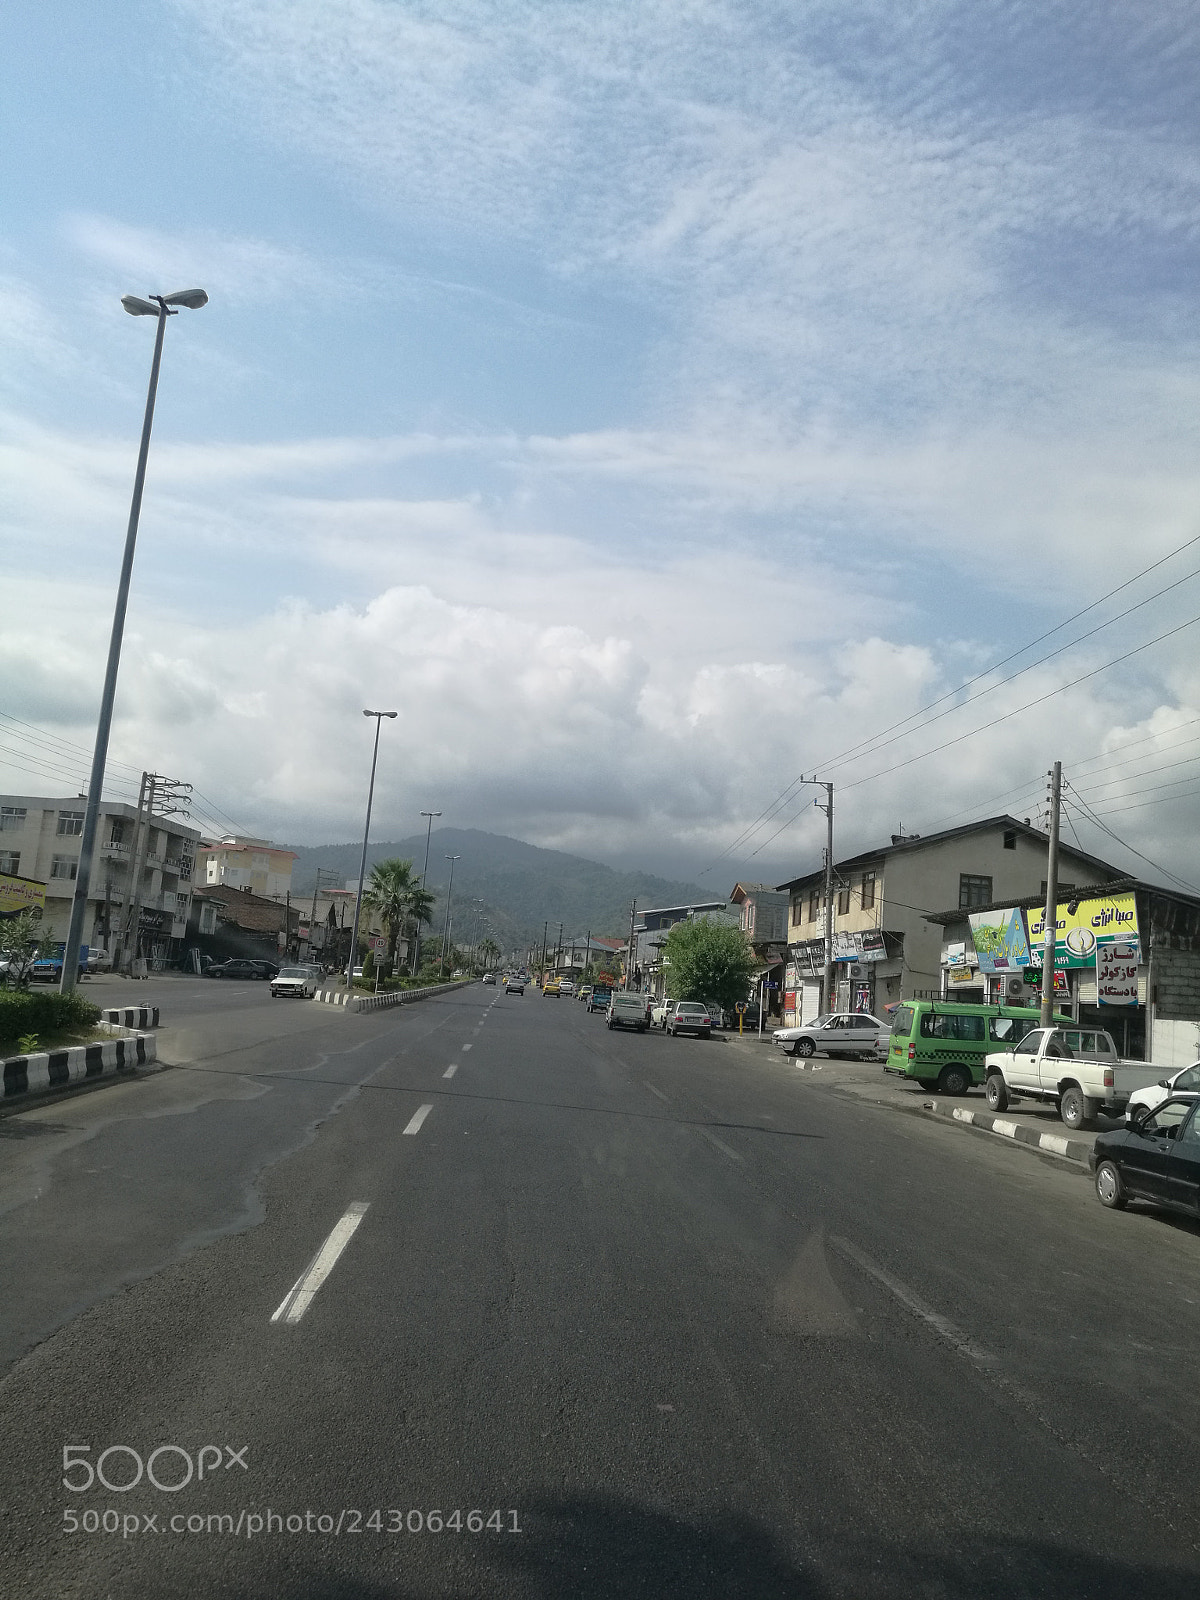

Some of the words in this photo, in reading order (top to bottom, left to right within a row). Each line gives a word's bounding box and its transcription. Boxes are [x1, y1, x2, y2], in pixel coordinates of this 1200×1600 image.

[1091, 908, 1114, 927] انرژی
[1115, 908, 1134, 926] صبا
[1101, 947, 1134, 963] شارژ
[1098, 965, 1121, 981] کولر
[1119, 966, 1137, 981] گاز
[1099, 985, 1130, 996] دستگاه
[1130, 986, 1138, 999] با
